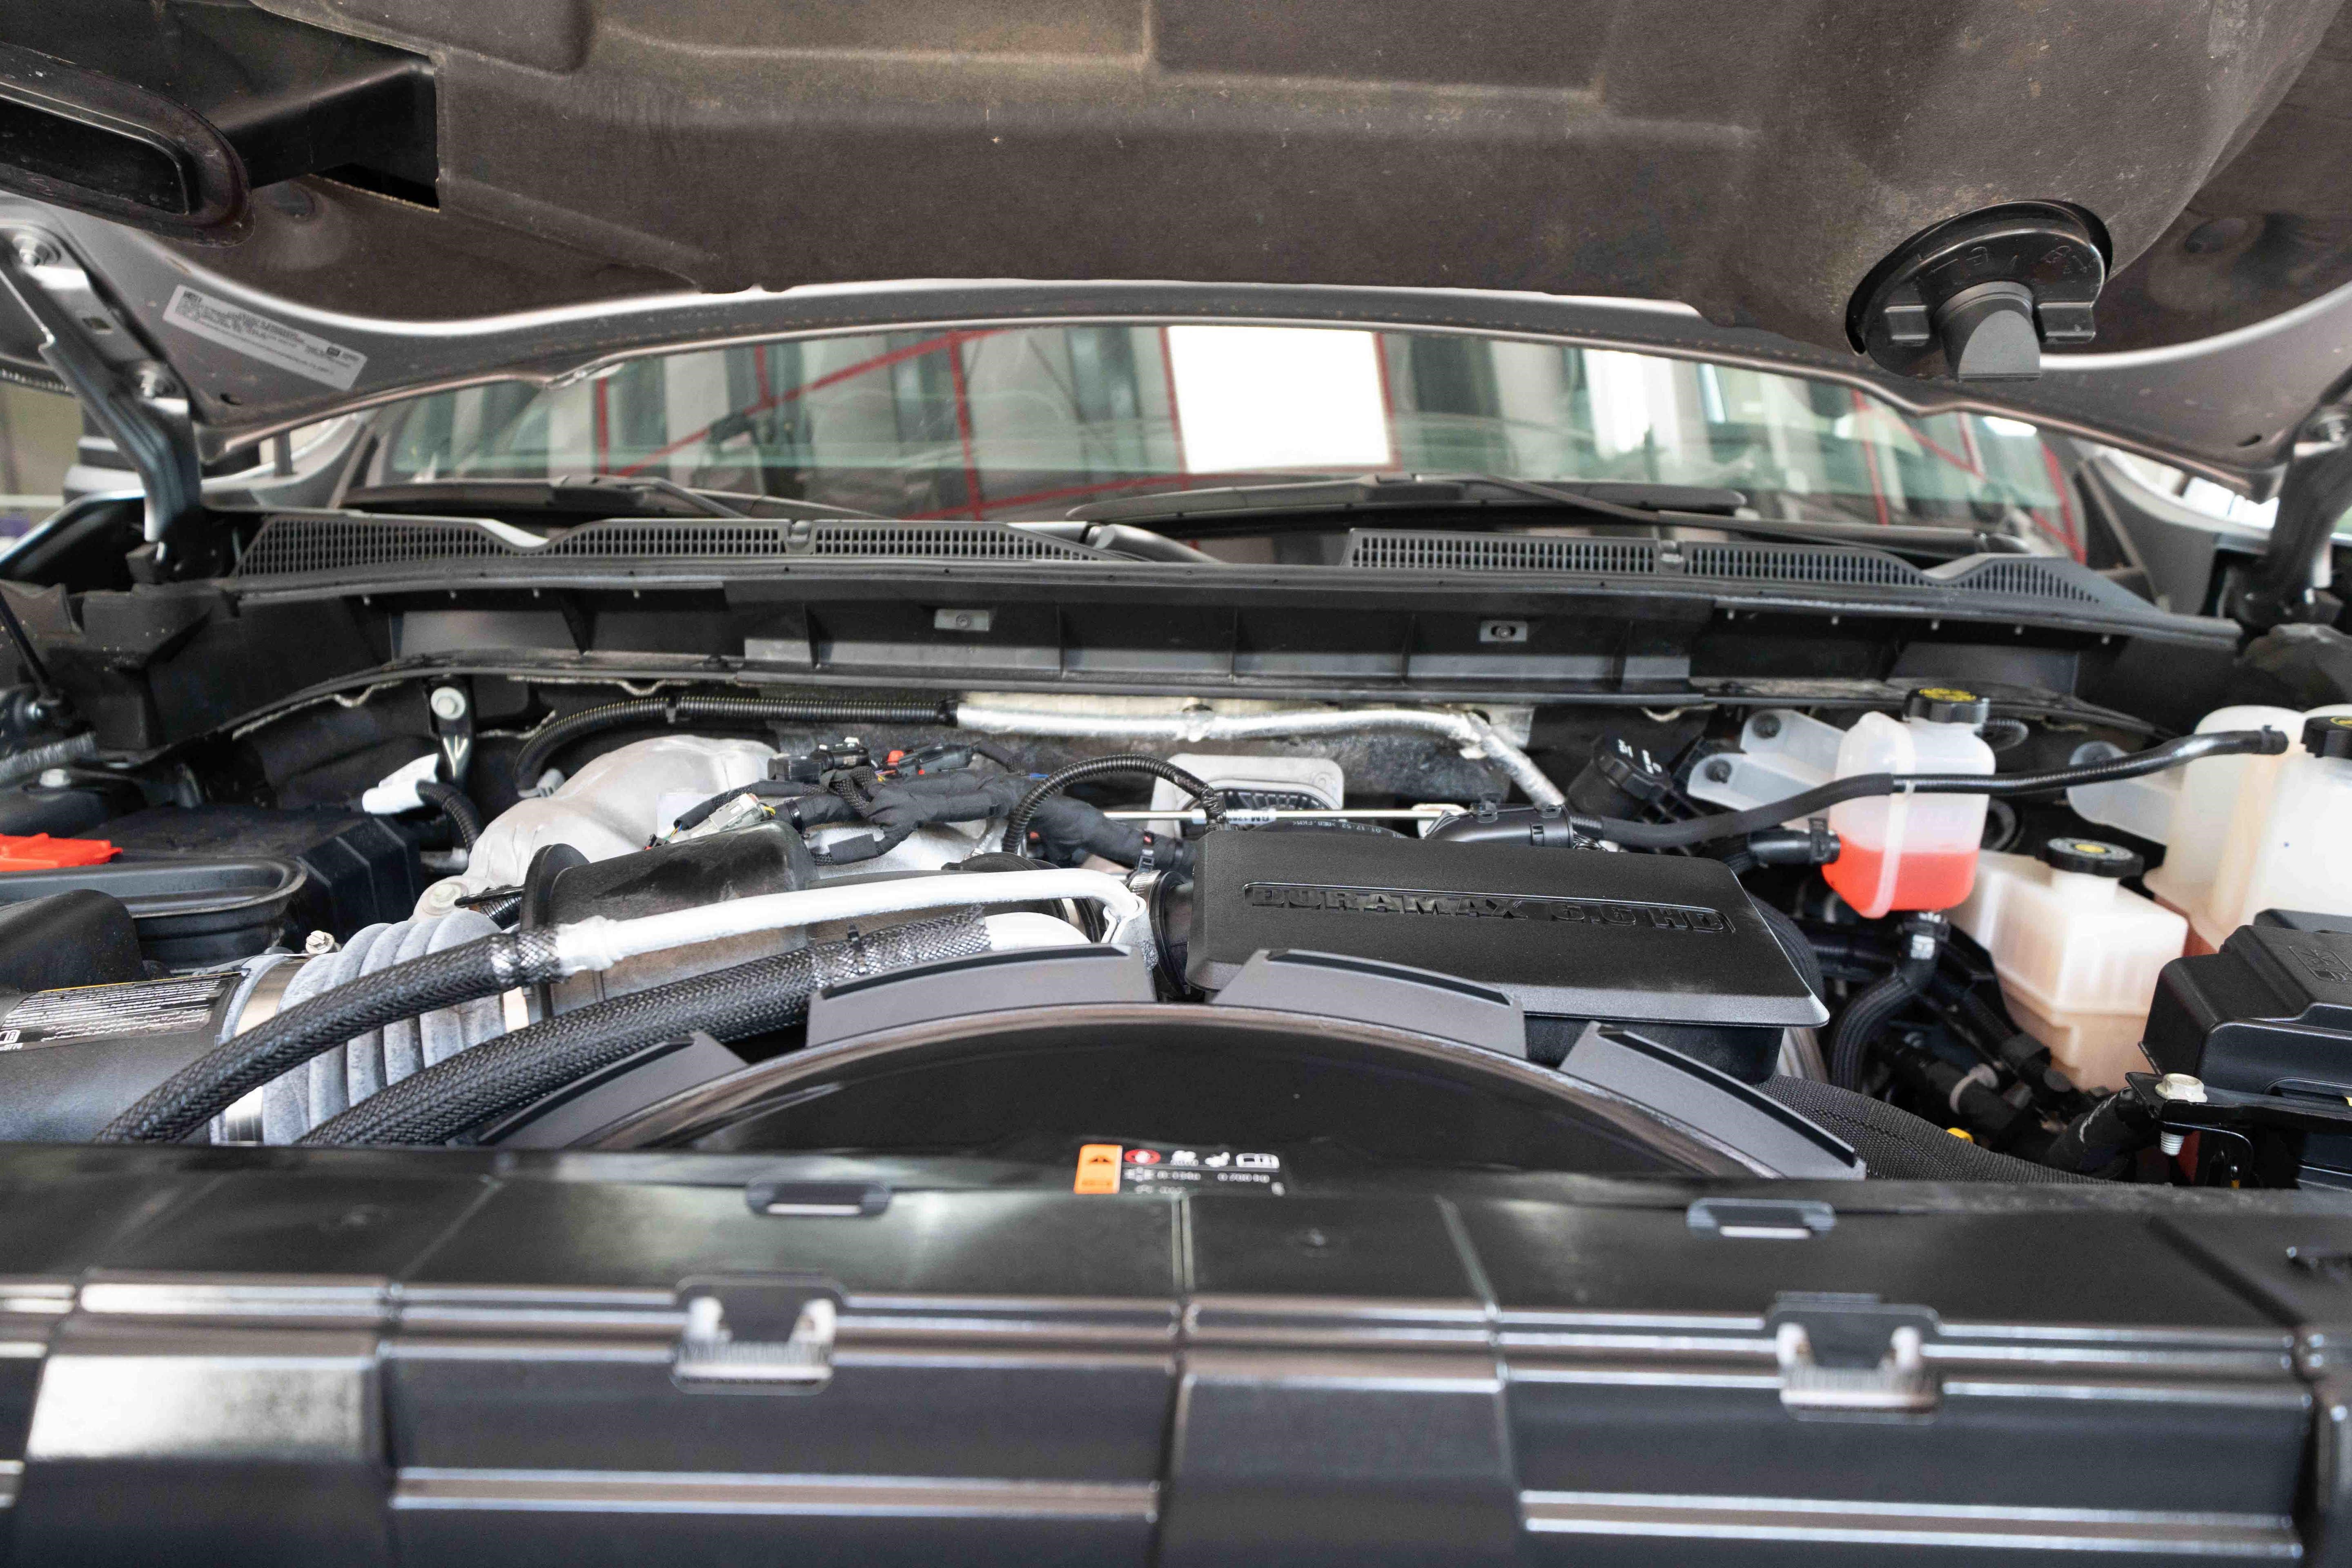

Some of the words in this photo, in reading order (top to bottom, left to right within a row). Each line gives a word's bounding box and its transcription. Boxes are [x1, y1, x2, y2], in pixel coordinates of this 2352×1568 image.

[1252, 888, 1528, 920] DURAMAX
[1550, 902, 1636, 925] 6.6
[1648, 907, 1724, 931] HD
